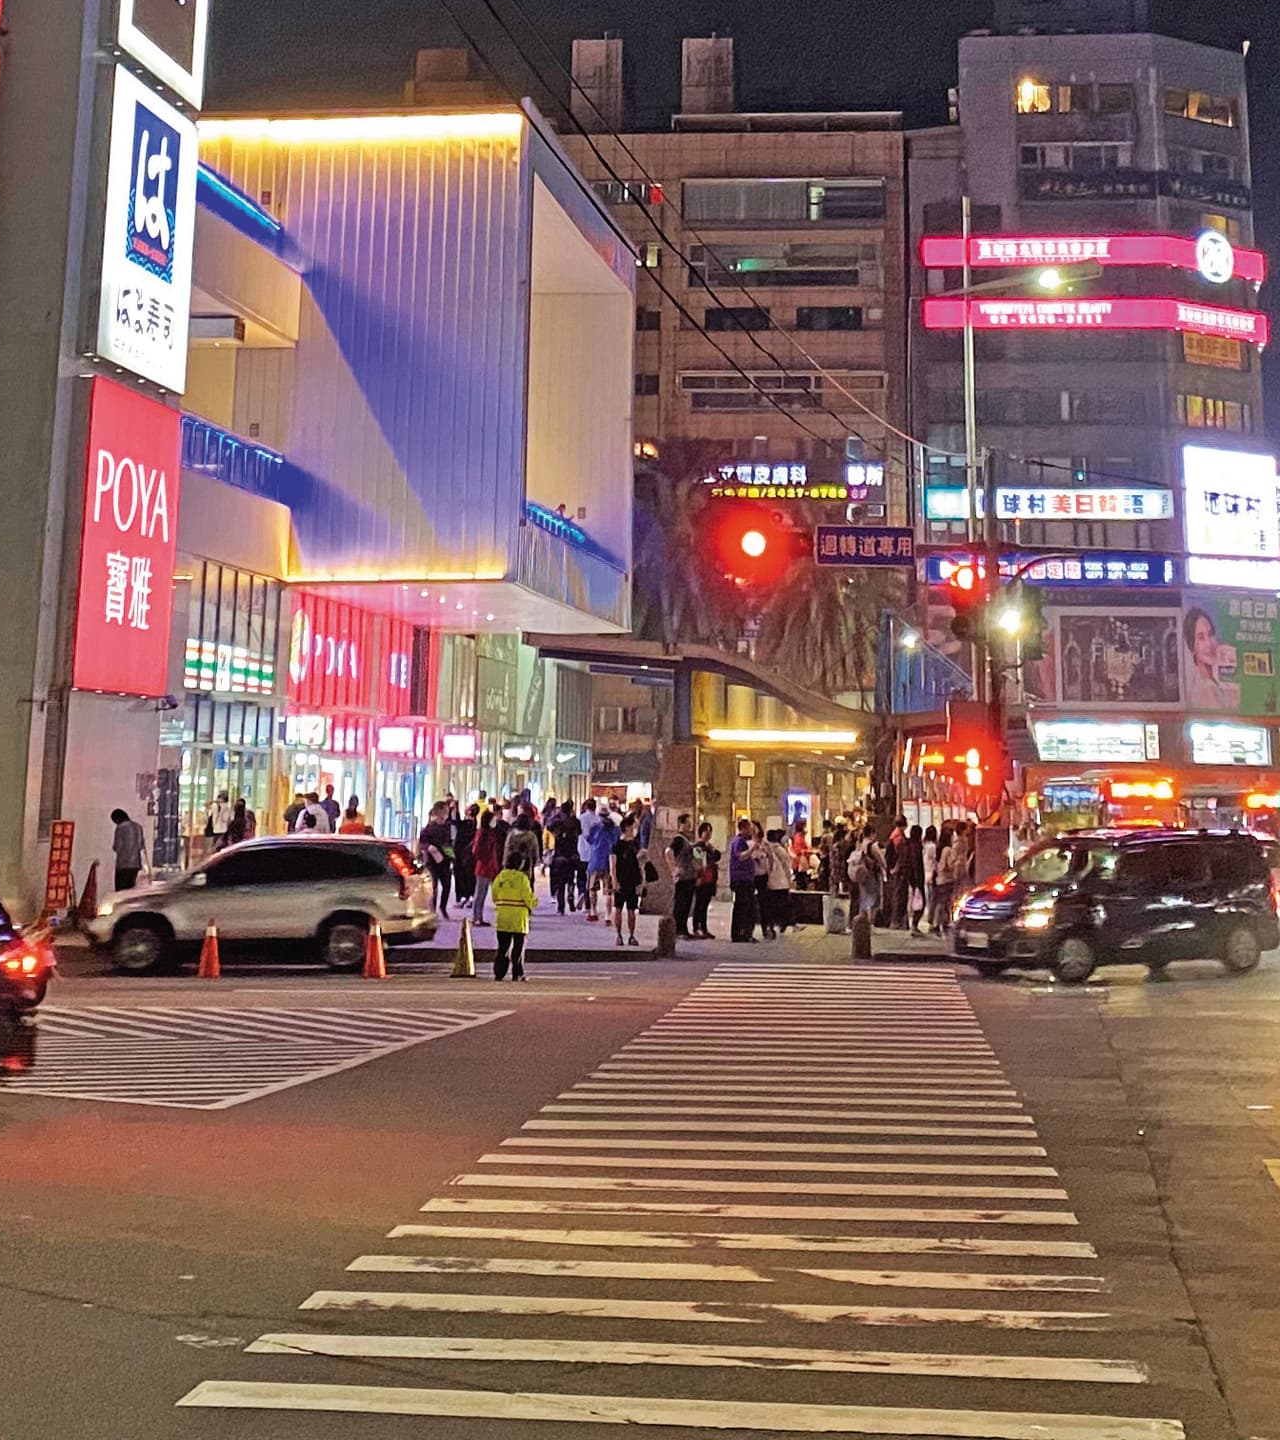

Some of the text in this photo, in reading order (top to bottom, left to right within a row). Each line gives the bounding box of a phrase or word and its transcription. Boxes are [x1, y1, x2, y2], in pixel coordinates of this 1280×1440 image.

[135, 130, 172, 250] は
[94, 449, 169, 544] POYA
[979, 492, 1145, 516] 球村美日韓語
[106, 551, 153, 631] 寶雅
